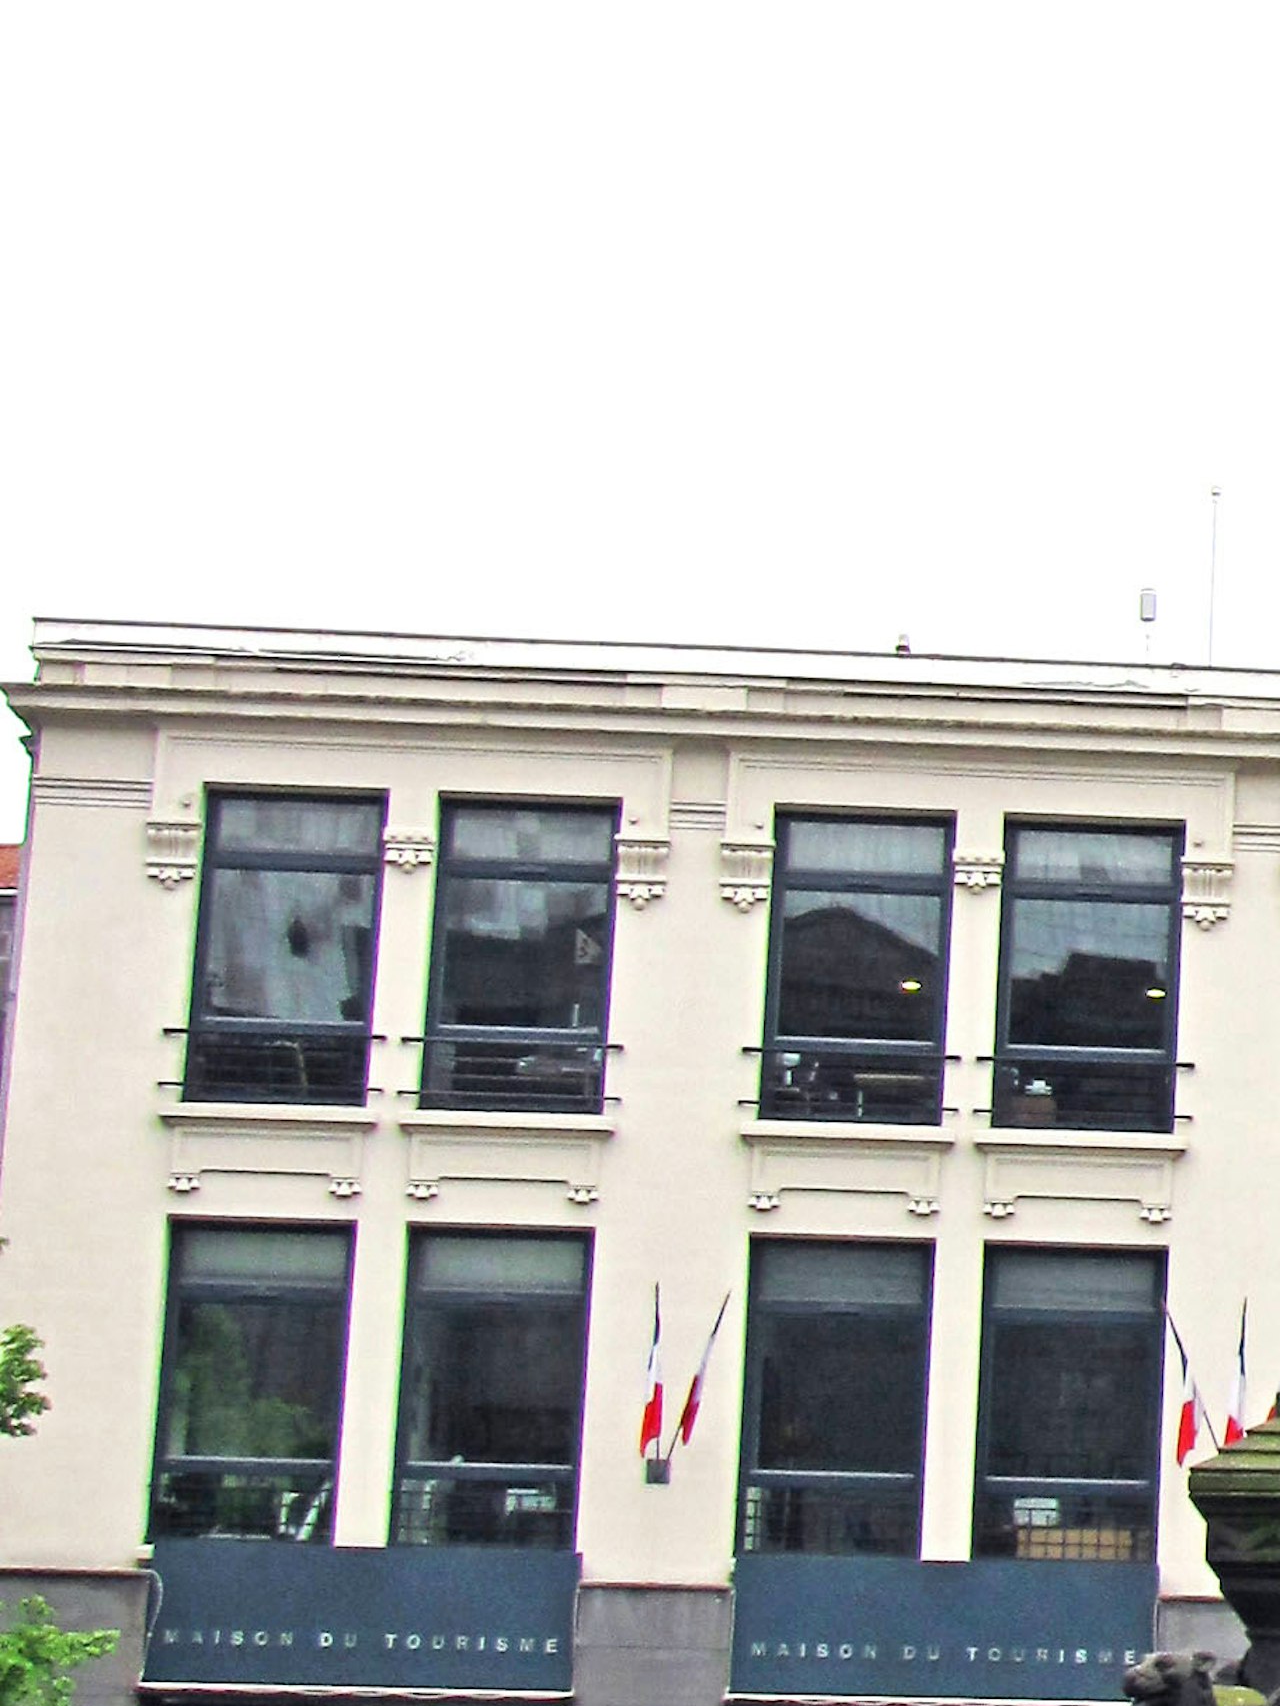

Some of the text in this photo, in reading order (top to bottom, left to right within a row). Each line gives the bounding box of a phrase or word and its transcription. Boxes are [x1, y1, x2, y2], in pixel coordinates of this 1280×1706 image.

[165, 1629, 559, 1653] MAISON DU TOURISME
[751, 1642, 1137, 1665] MAISON DU TOURISME
